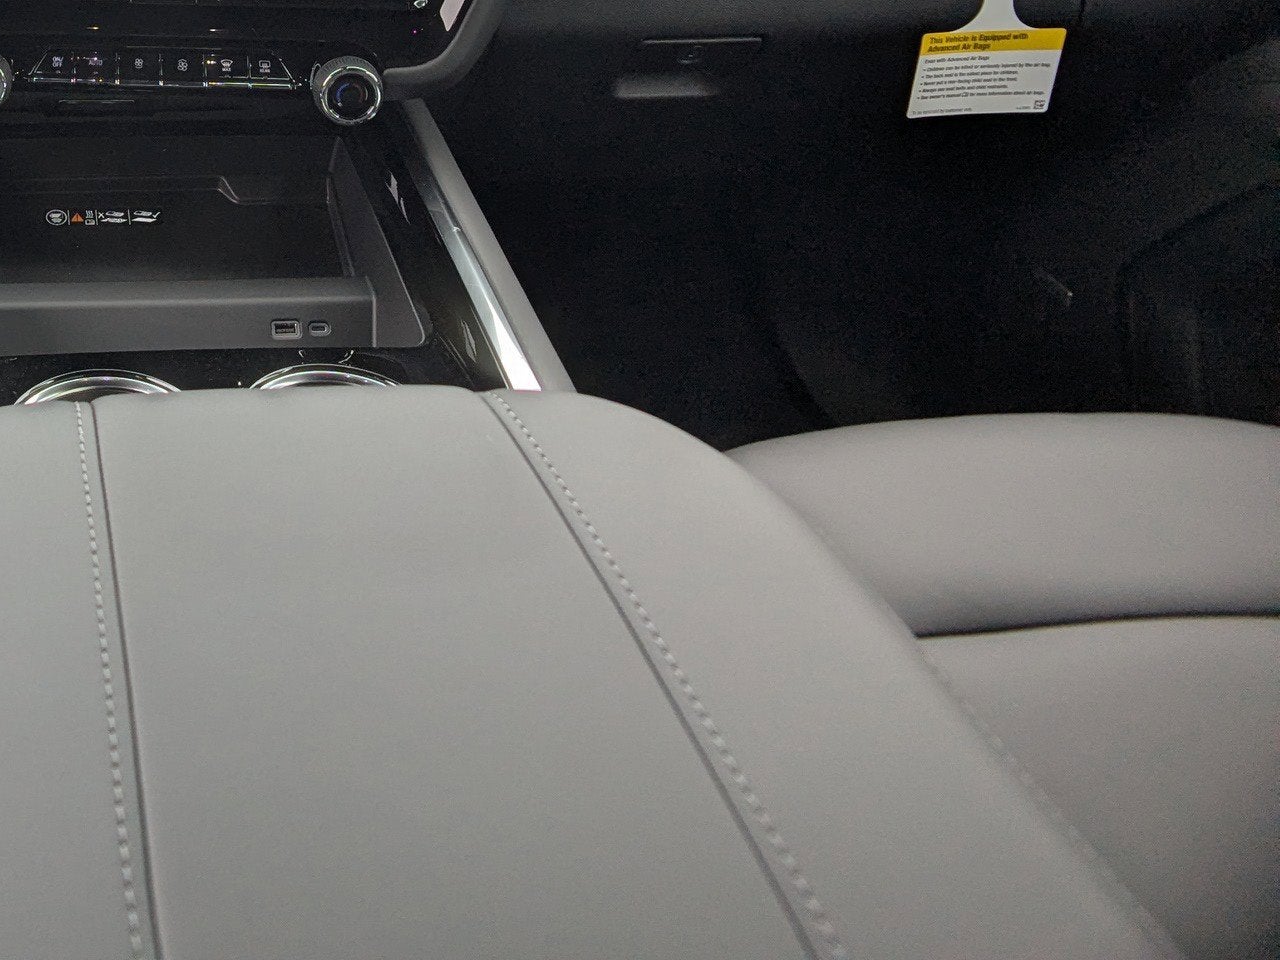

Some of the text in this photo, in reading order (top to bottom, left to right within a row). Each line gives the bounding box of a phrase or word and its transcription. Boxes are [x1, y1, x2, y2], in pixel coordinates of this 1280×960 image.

[945, 35, 970, 43] Vehicle
[971, 34, 977, 42] is
[979, 33, 1011, 42] Equipped
[927, 44, 960, 52] Advanced
[973, 43, 991, 51] Bags
[52, 60, 63, 68] OFF
